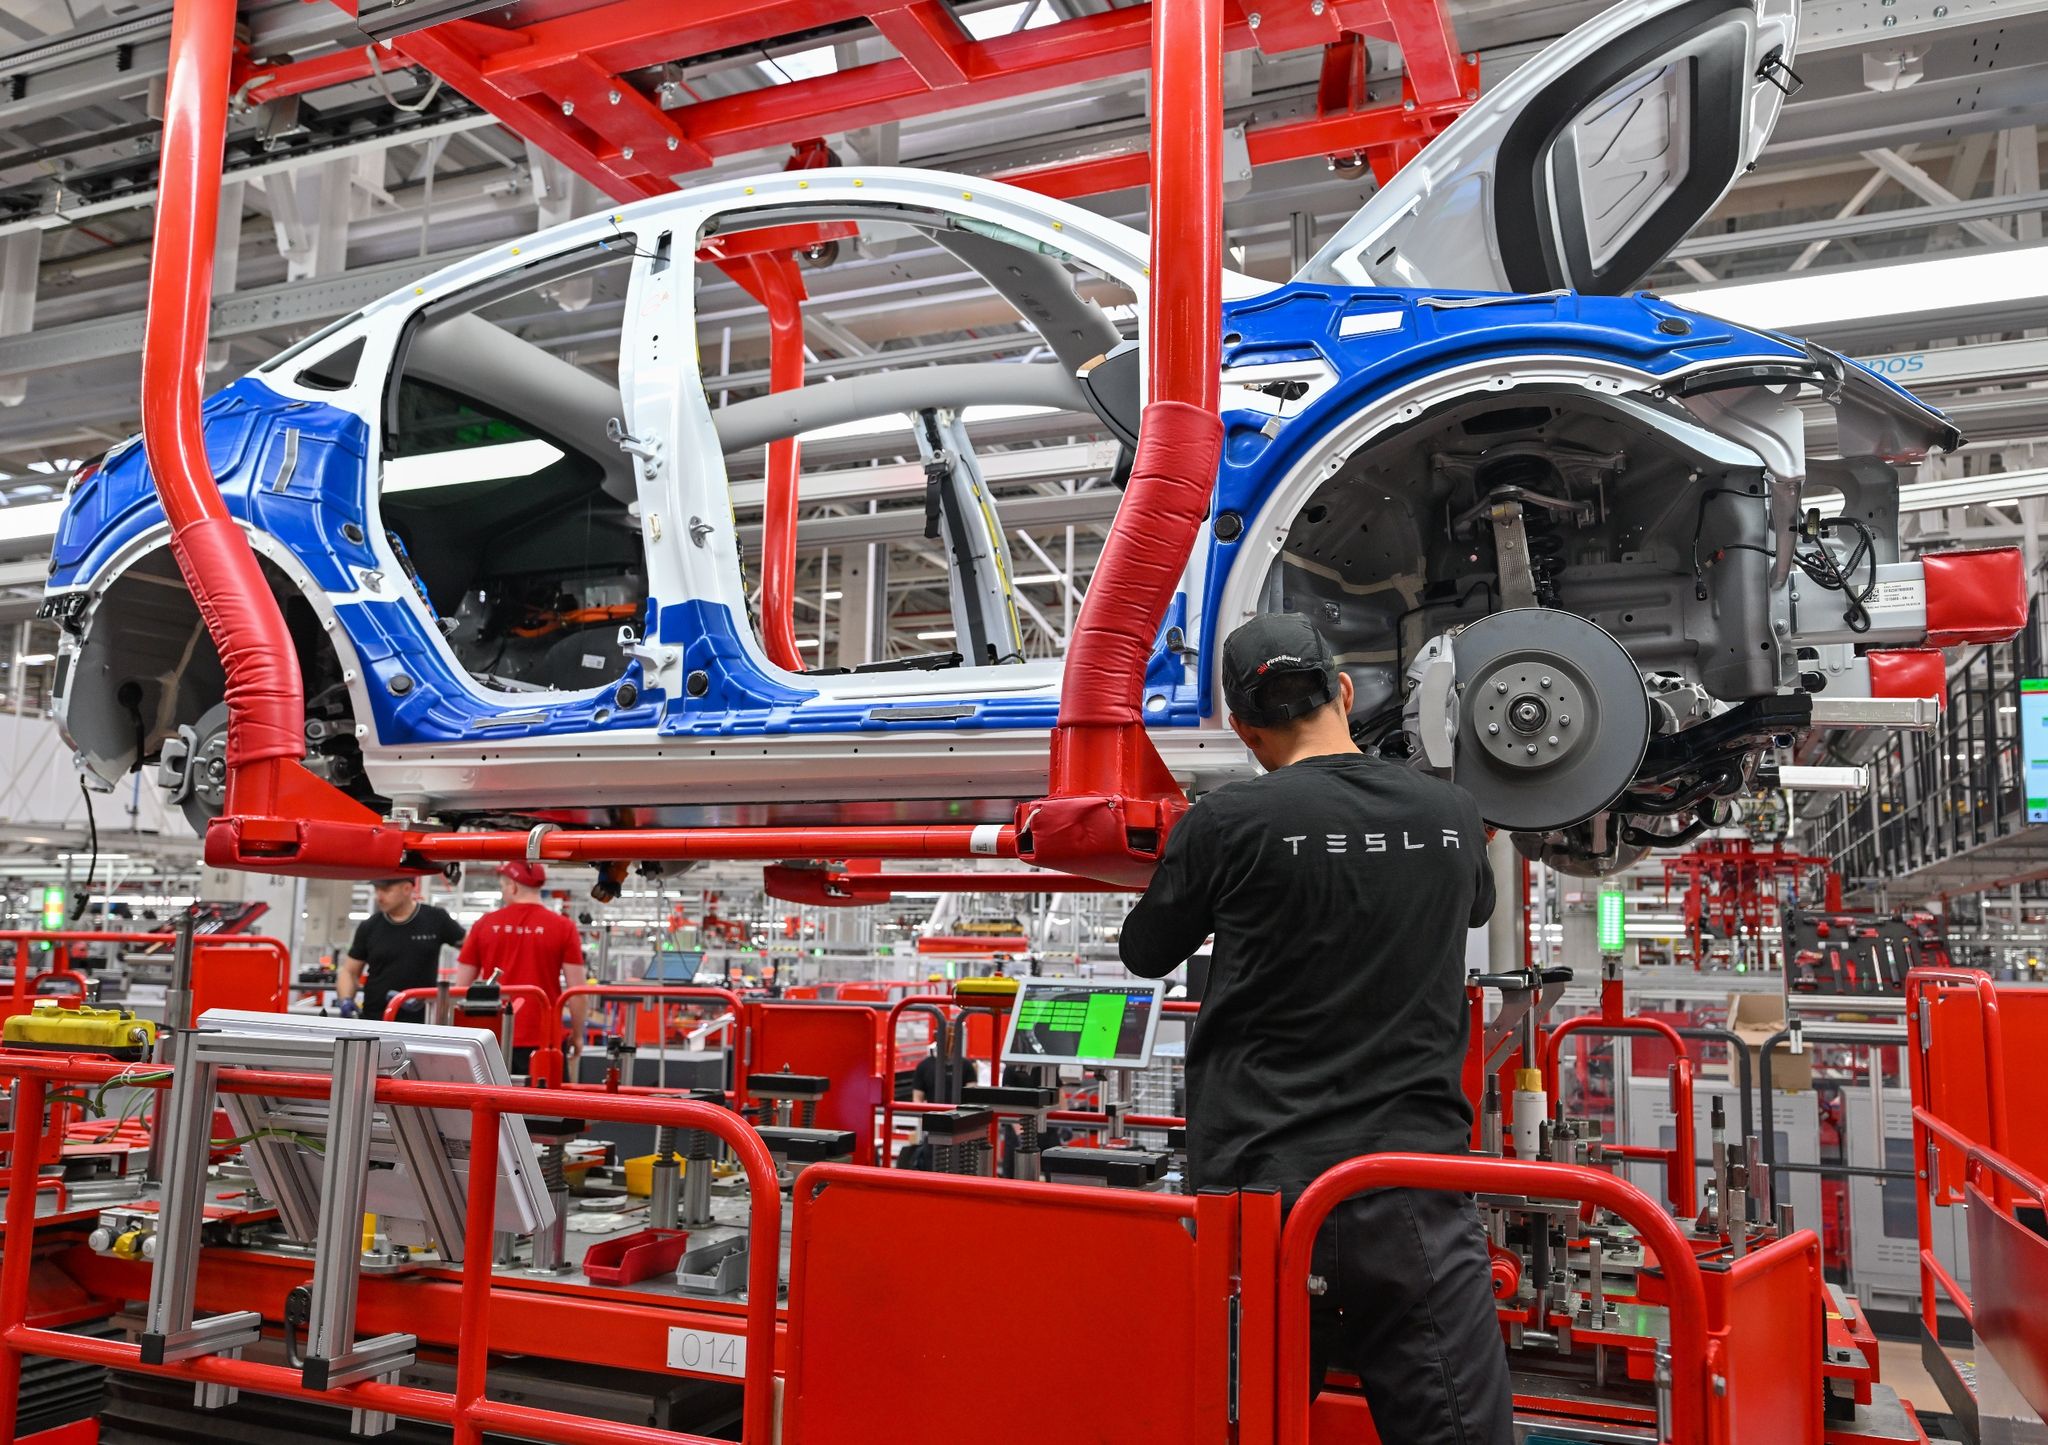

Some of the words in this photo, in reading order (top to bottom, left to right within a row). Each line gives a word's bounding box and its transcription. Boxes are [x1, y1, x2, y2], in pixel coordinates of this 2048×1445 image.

[1282, 829, 1460, 856] TESLA
[491, 924, 545, 935] TESLA
[681, 1333, 737, 1373] 014
